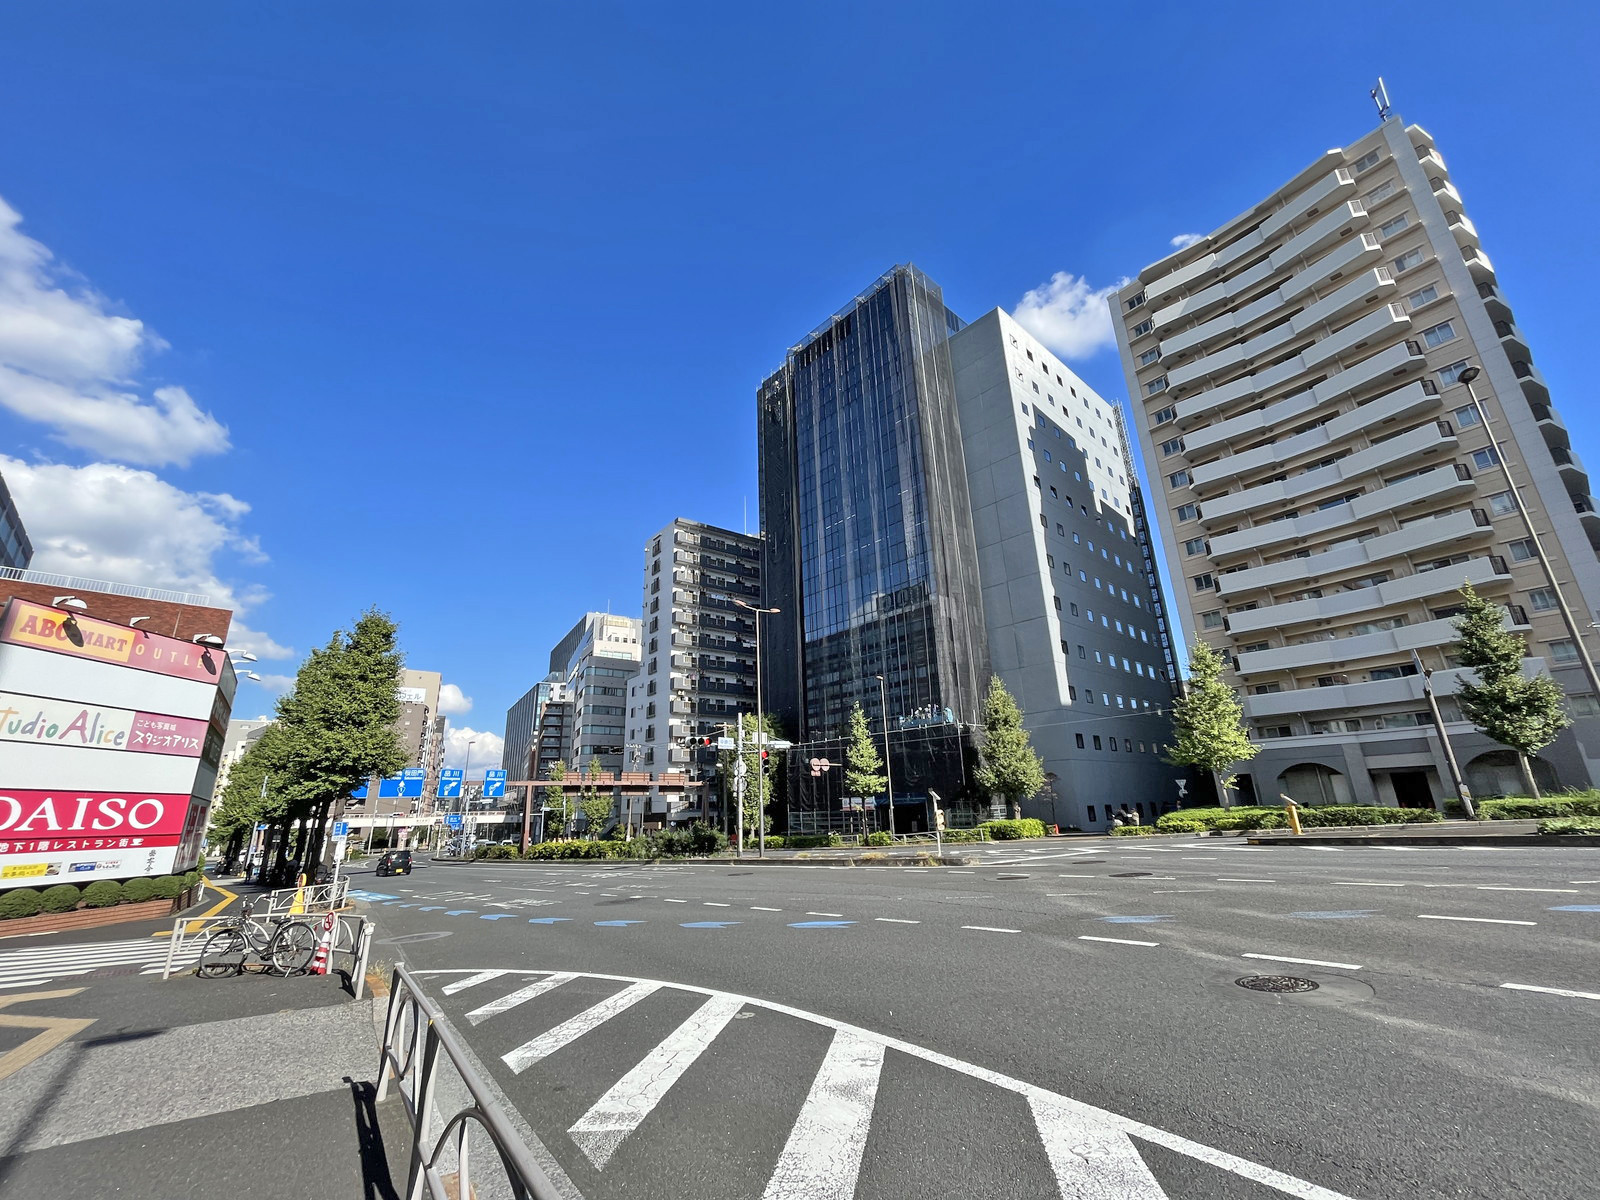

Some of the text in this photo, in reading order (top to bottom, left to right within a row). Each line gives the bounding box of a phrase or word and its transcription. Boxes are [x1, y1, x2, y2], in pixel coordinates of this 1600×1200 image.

[20, 615, 210, 670] ABCMART OUTLE
[0, 707, 125, 746] tudio Alice
[132, 730, 199, 750] スタジオアリス
